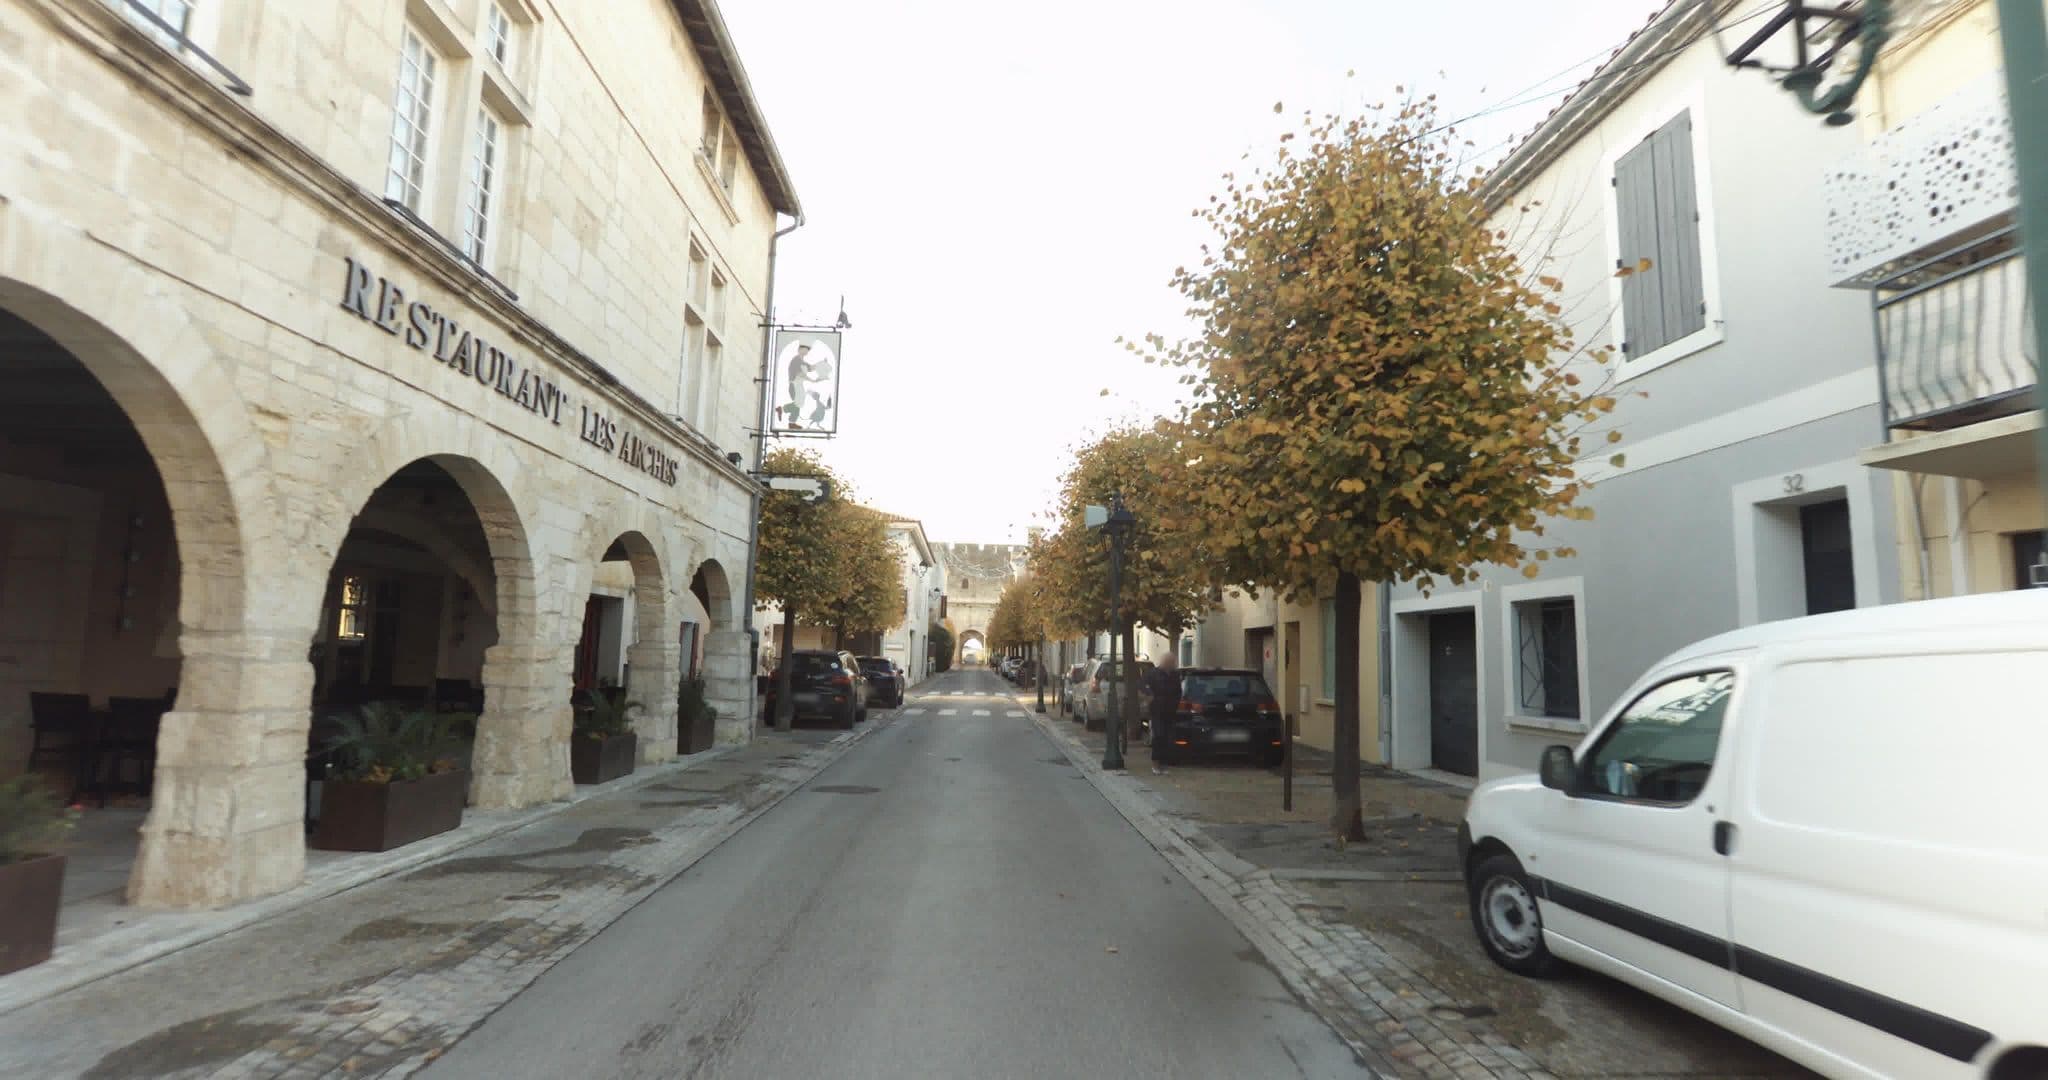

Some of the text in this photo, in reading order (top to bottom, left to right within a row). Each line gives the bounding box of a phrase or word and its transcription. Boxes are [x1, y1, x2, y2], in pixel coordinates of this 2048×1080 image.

[340, 257, 678, 488] RESTAURANT LES ARCHES
[1783, 473, 1804, 493] 32
